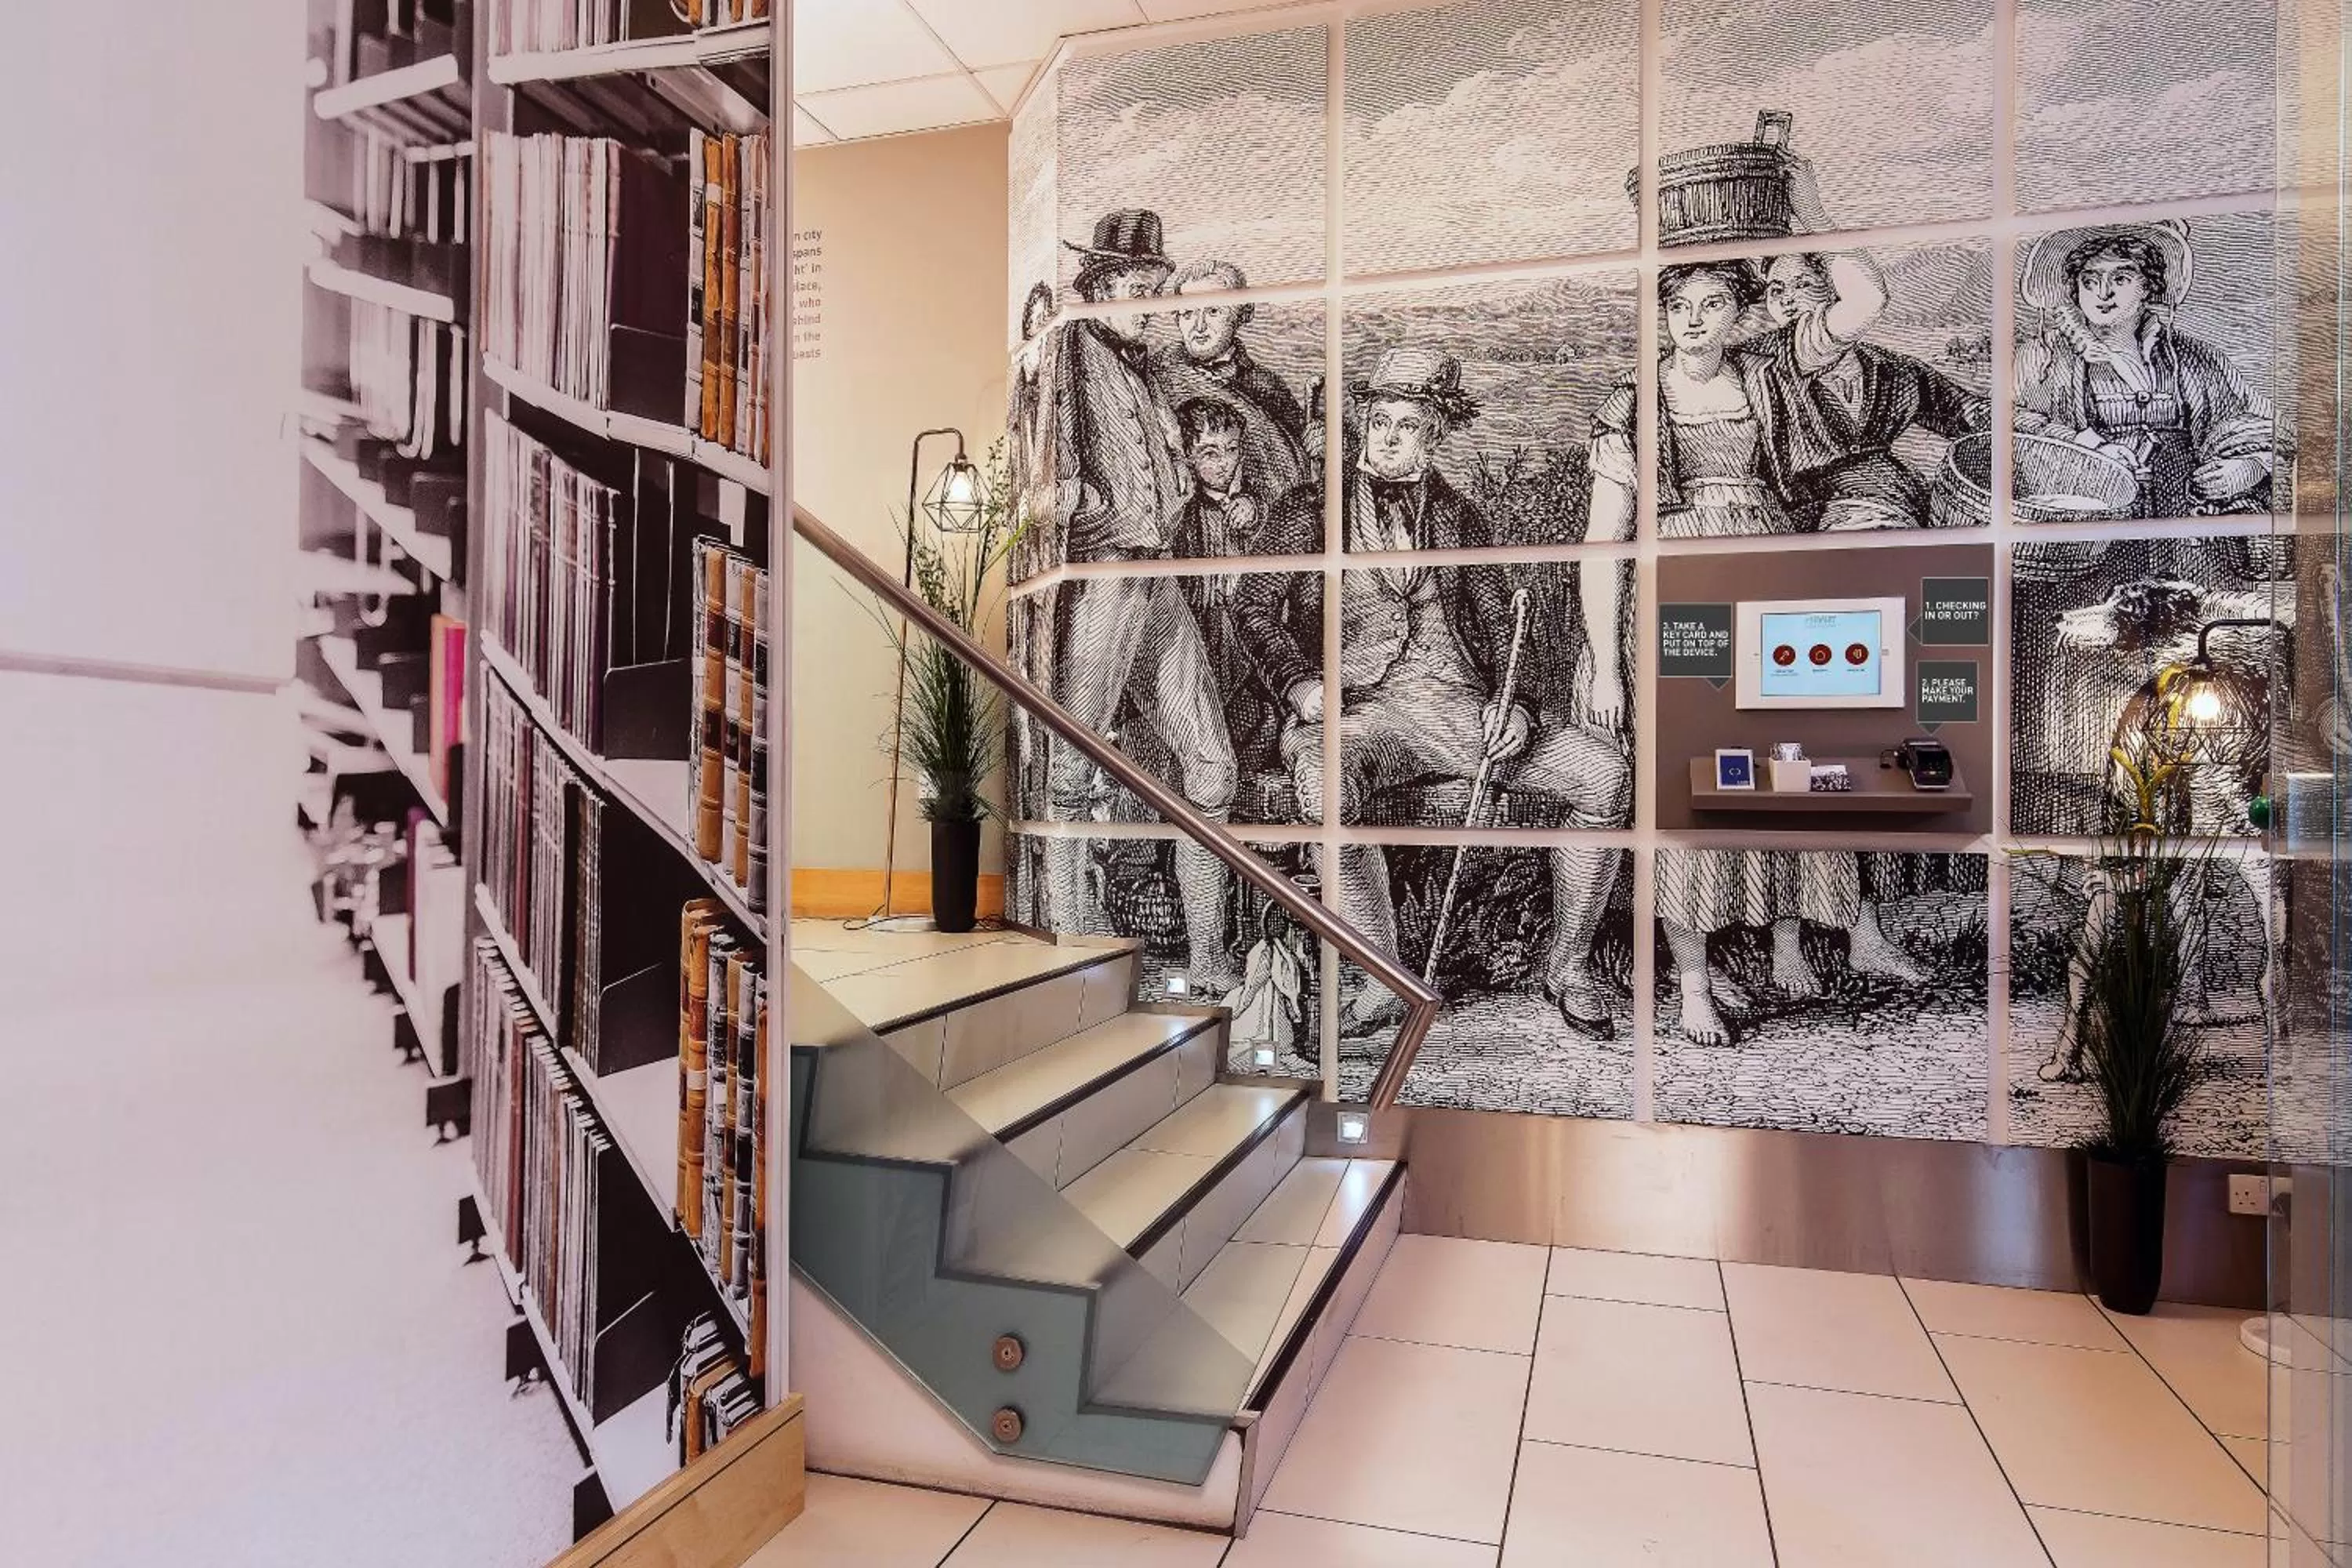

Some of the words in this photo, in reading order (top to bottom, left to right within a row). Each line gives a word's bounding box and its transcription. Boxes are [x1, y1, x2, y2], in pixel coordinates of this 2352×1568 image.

[804, 230, 822, 241] city
[811, 263, 822, 273] in
[793, 281, 822, 292] lace,
[800, 297, 821, 307] who
[804, 331, 820, 342] the
[1925, 601, 1934, 610] 1.
[1936, 601, 1986, 610] CHECKING
[1925, 611, 1936, 619] IN
[1937, 611, 1951, 619] OR
[1953, 611, 1980, 620] OUT?
[1663, 630, 1681, 639] KEY
[1682, 630, 1708, 639] CARD
[1709, 630, 1729, 639] AND
[1922, 686, 1947, 695] MAKE
[1950, 686, 1973, 695] YOUR
[1922, 695, 1966, 703] PAYMENT.
